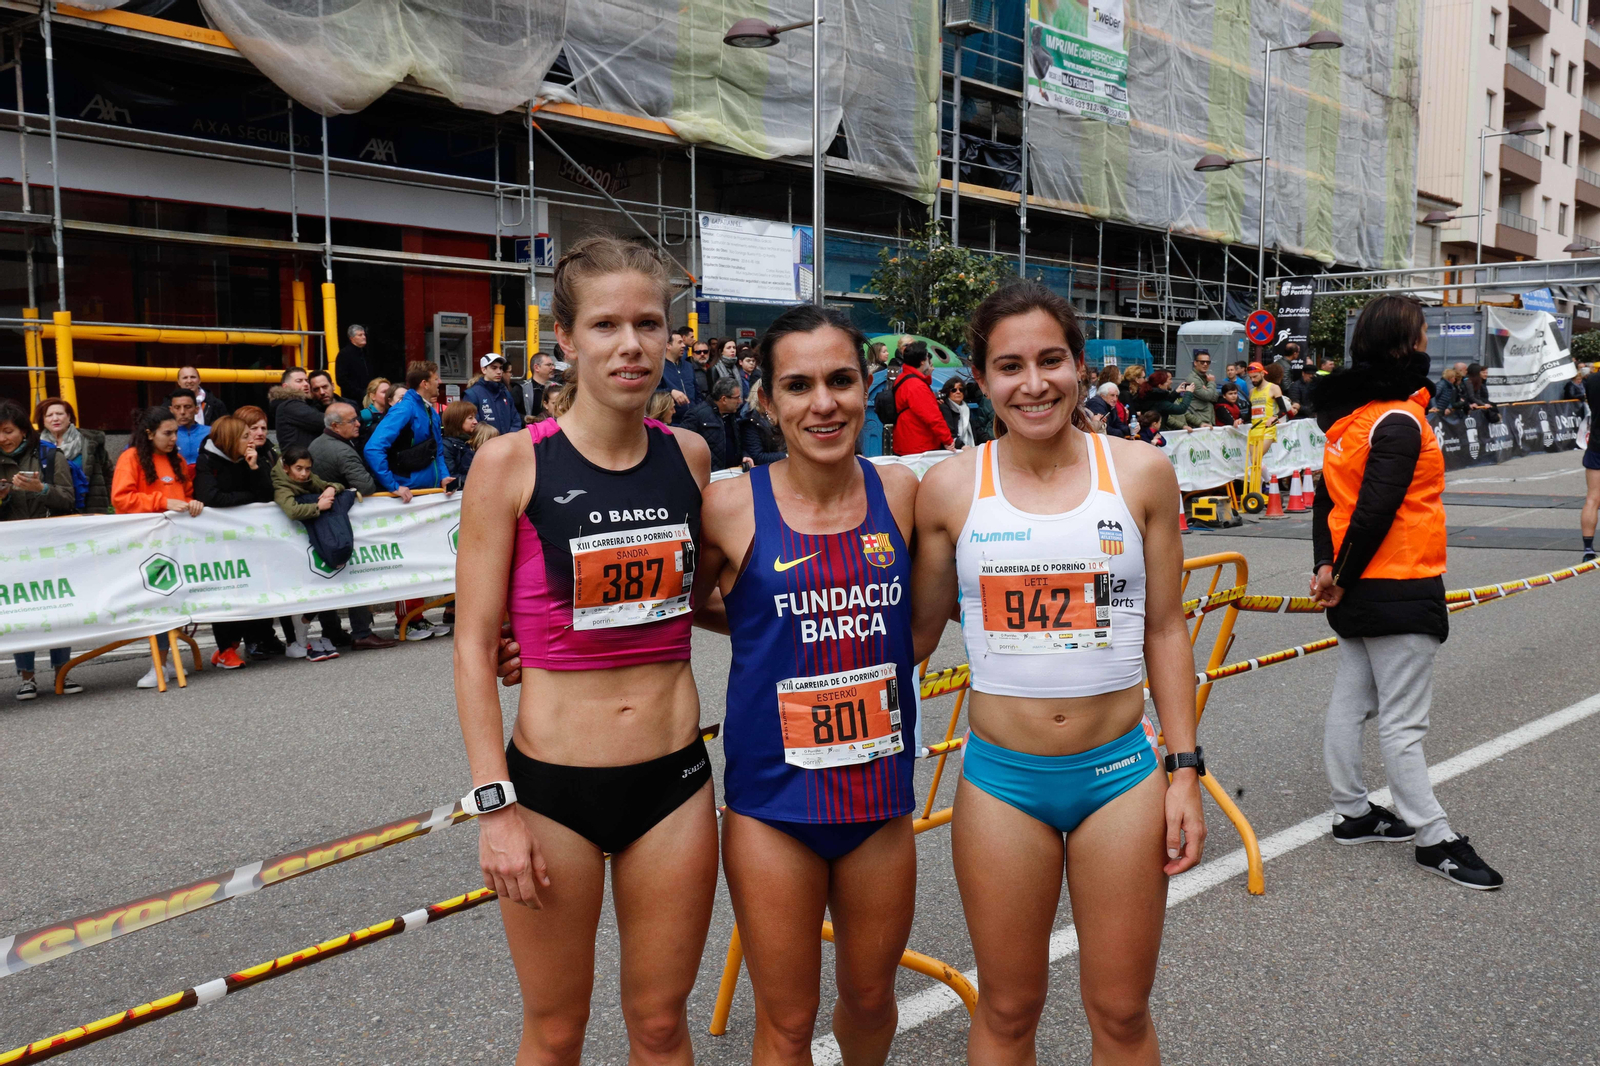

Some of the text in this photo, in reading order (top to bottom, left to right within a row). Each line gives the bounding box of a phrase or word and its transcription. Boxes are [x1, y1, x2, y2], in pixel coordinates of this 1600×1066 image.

[1099, 13, 1121, 29] weber
[1046, 34, 1080, 57] IMPRIME
[192, 118, 231, 137] AXA
[359, 137, 398, 165] AXA
[1290, 288, 1312, 296] Porriño
[1285, 306, 1310, 314] Porriño
[589, 507, 669, 524] O BARCO
[577, 529, 687, 551] XIII CARREIRA DE O PORRIÑO 10 K
[970, 528, 1032, 543] hummel
[349, 542, 404, 566] RAMA
[616, 548, 649, 560] SANDRA
[183, 558, 251, 584] RAMA
[349, 564, 404, 575] elevacionesrama.com
[982, 565, 993, 574] XIII
[995, 565, 1029, 573] CARREIRA
[1043, 564, 1049, 572] O
[1051, 561, 1086, 571] PORRIÑO
[1088, 562, 1097, 570] 10
[188, 583, 249, 594] elevacionesrama.com
[602, 557, 664, 604] 387
[1024, 577, 1049, 587] LETI
[1110, 573, 1127, 593] ia
[0, 577, 76, 606] RAMA
[774, 575, 902, 618] FUNDACIÓ
[1005, 588, 1072, 630] 942
[1111, 597, 1134, 608] orts
[801, 612, 887, 643] BARÇA
[795, 679, 829, 690] CARREIRA
[831, 678, 840, 687] DE
[842, 676, 848, 684] O
[850, 670, 880, 682] PORRIÑO
[880, 669, 888, 677] 10
[816, 687, 857, 702] ESTERXÜ
[811, 698, 868, 745] 801
